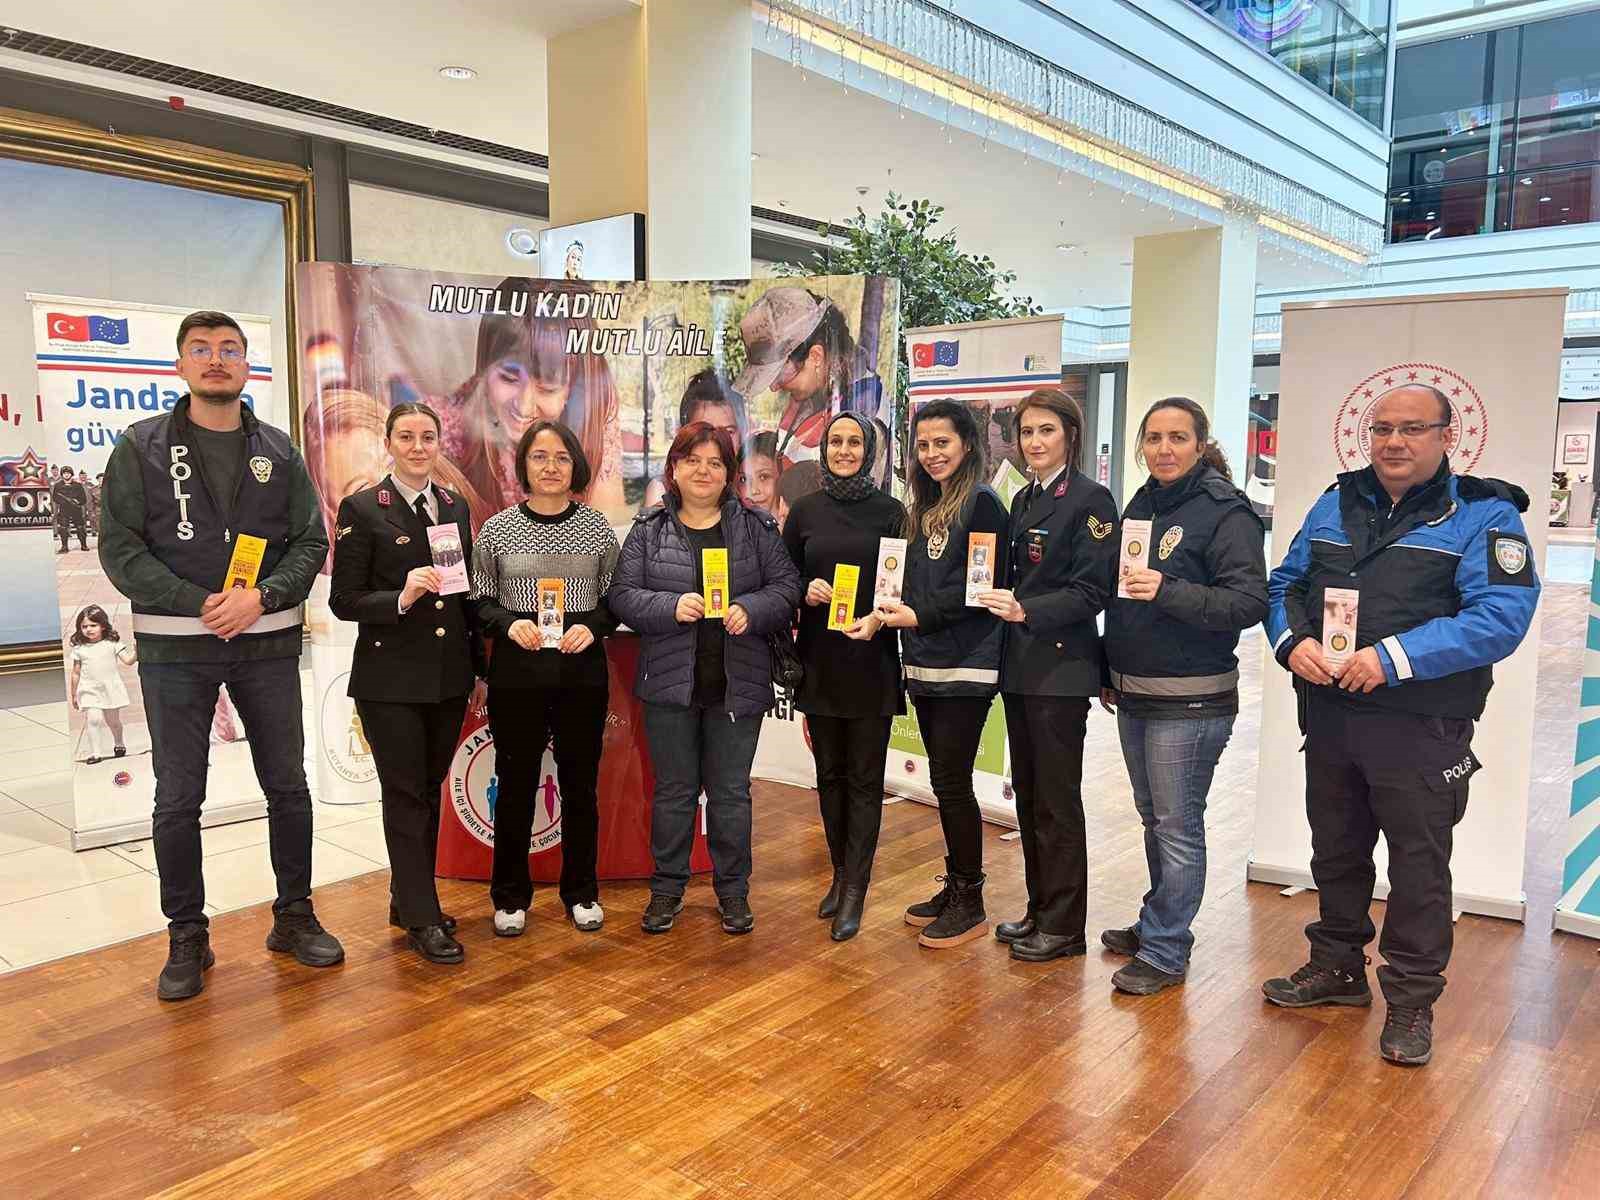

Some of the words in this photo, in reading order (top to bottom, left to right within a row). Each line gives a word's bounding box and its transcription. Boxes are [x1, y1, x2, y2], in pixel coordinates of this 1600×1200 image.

[429, 284, 528, 317] MUTLU
[534, 292, 622, 321] KADIN
[565, 328, 663, 356] MUTLU
